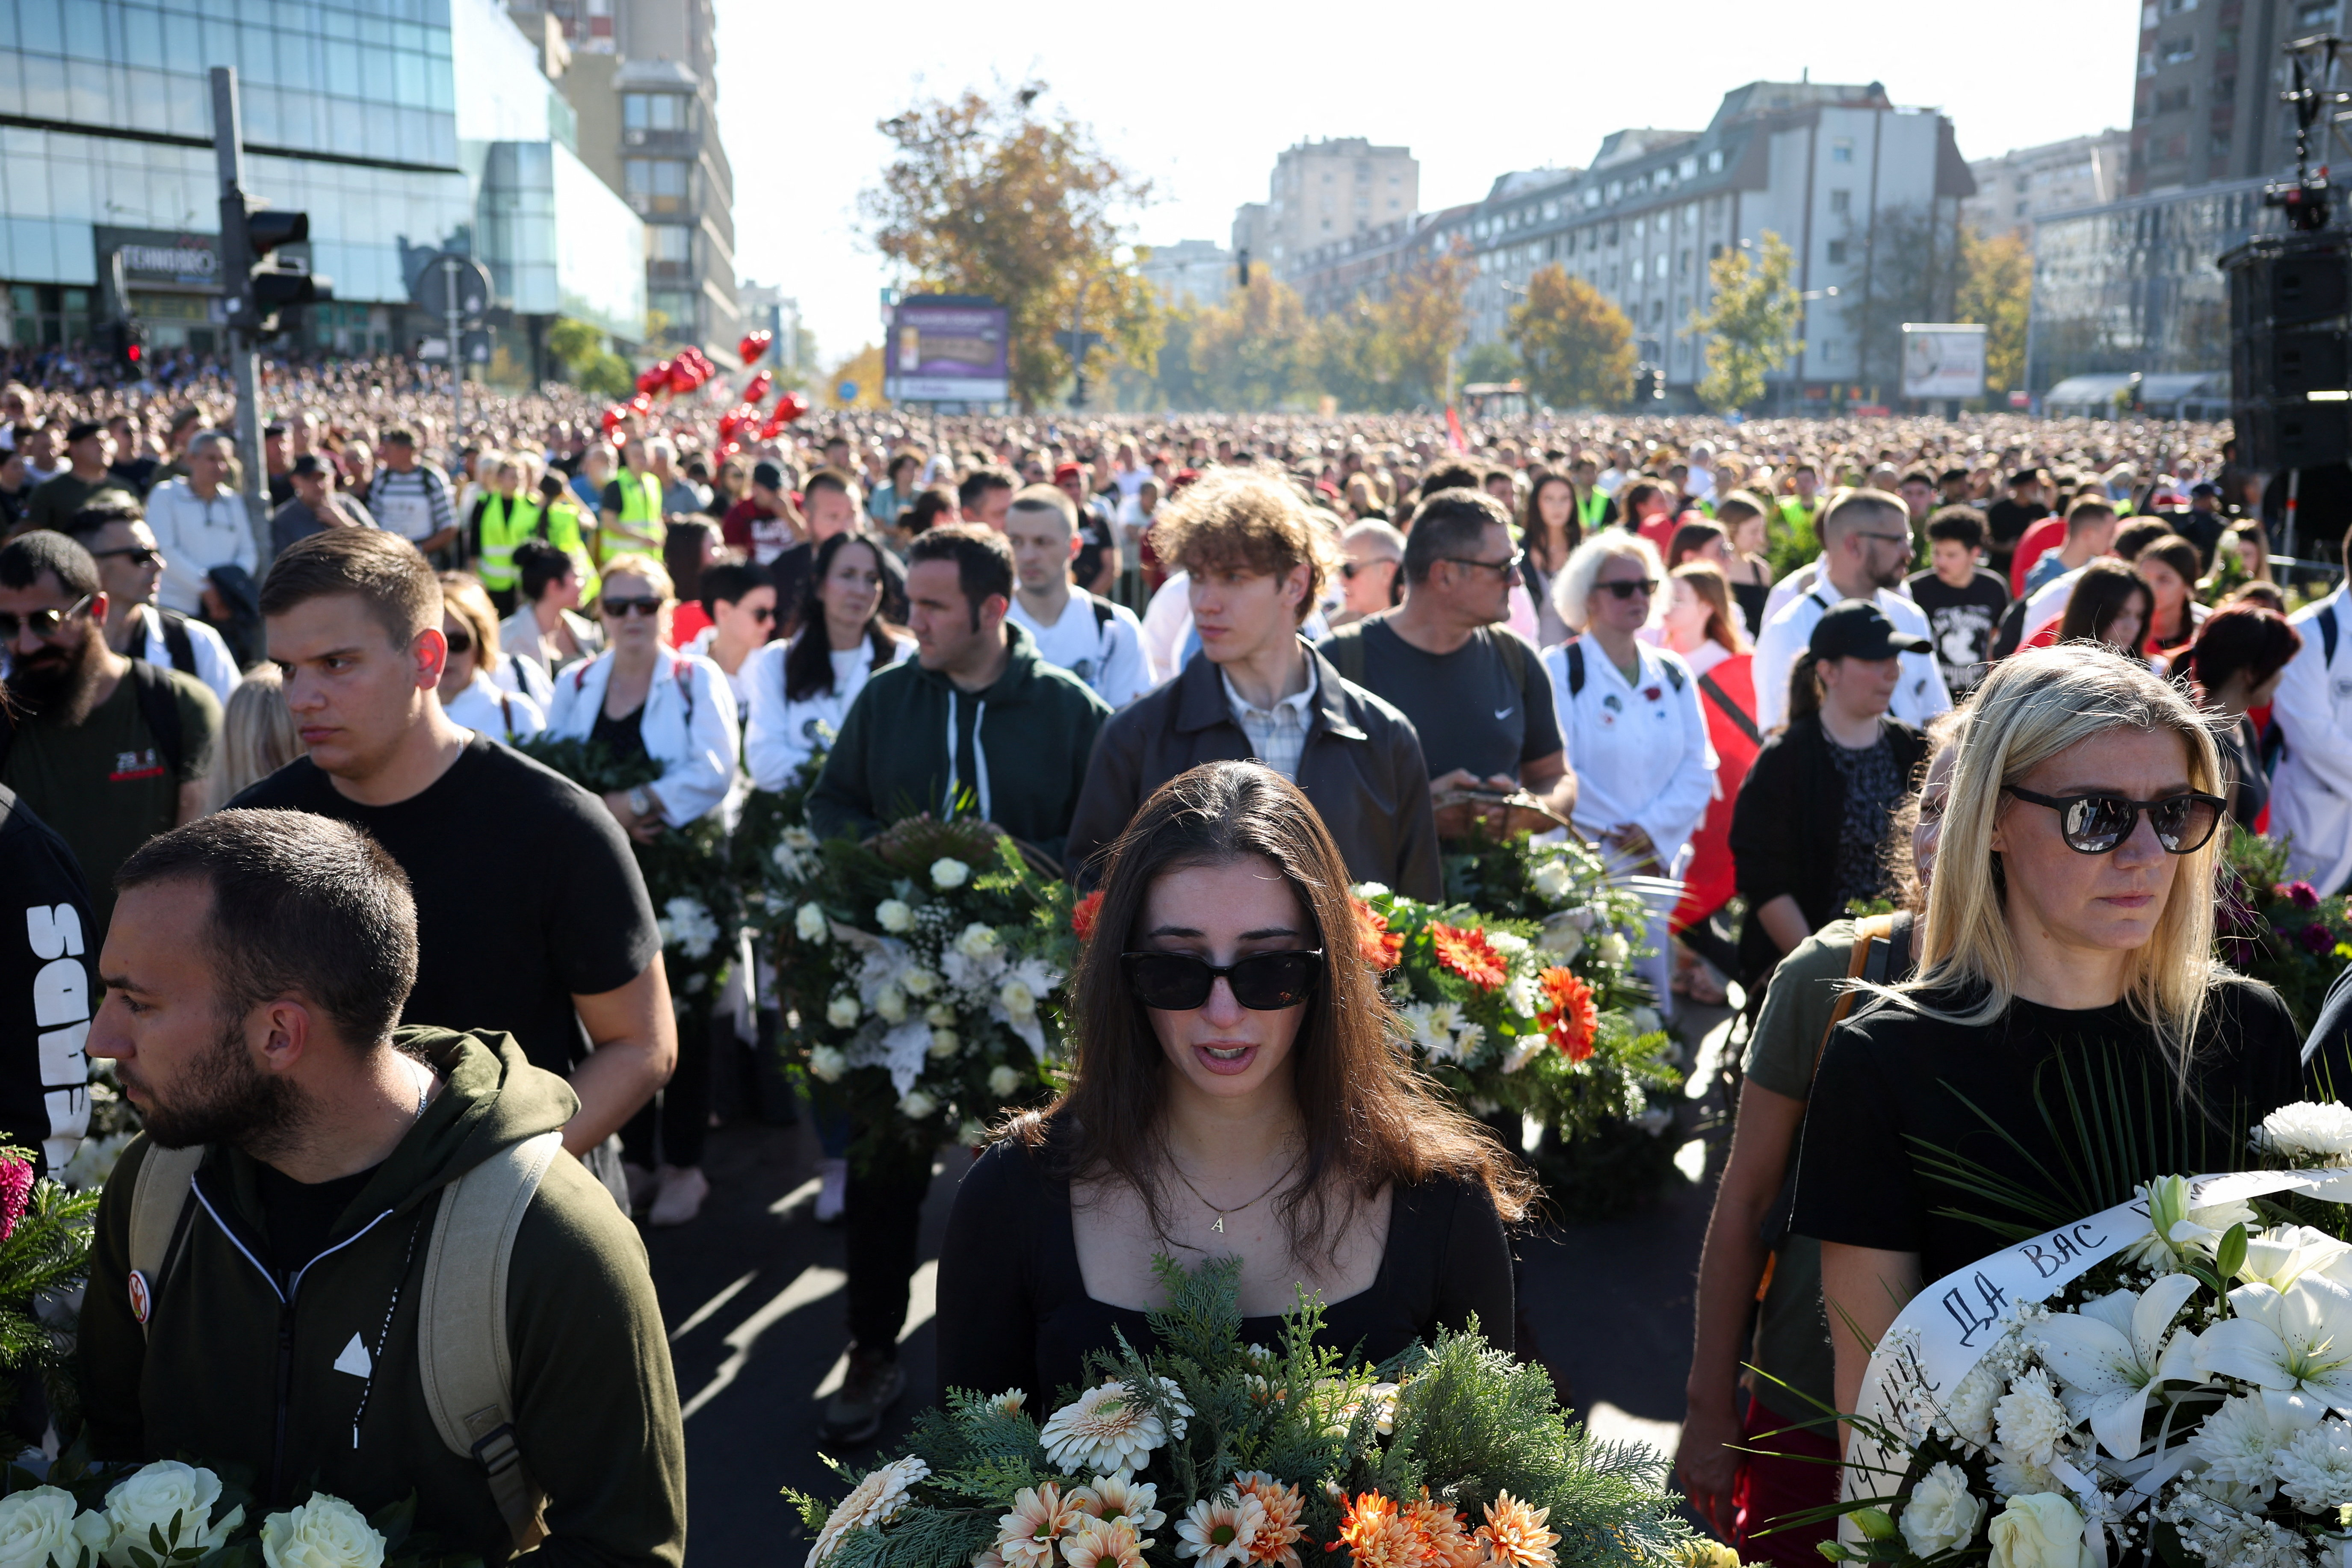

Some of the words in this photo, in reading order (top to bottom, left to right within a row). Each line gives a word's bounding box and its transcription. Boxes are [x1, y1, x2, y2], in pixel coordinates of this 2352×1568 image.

[1210, 1217, 1224, 1234] A
[1942, 1271, 2009, 1348] ДА
[2019, 1223, 2108, 1279] ВАС
